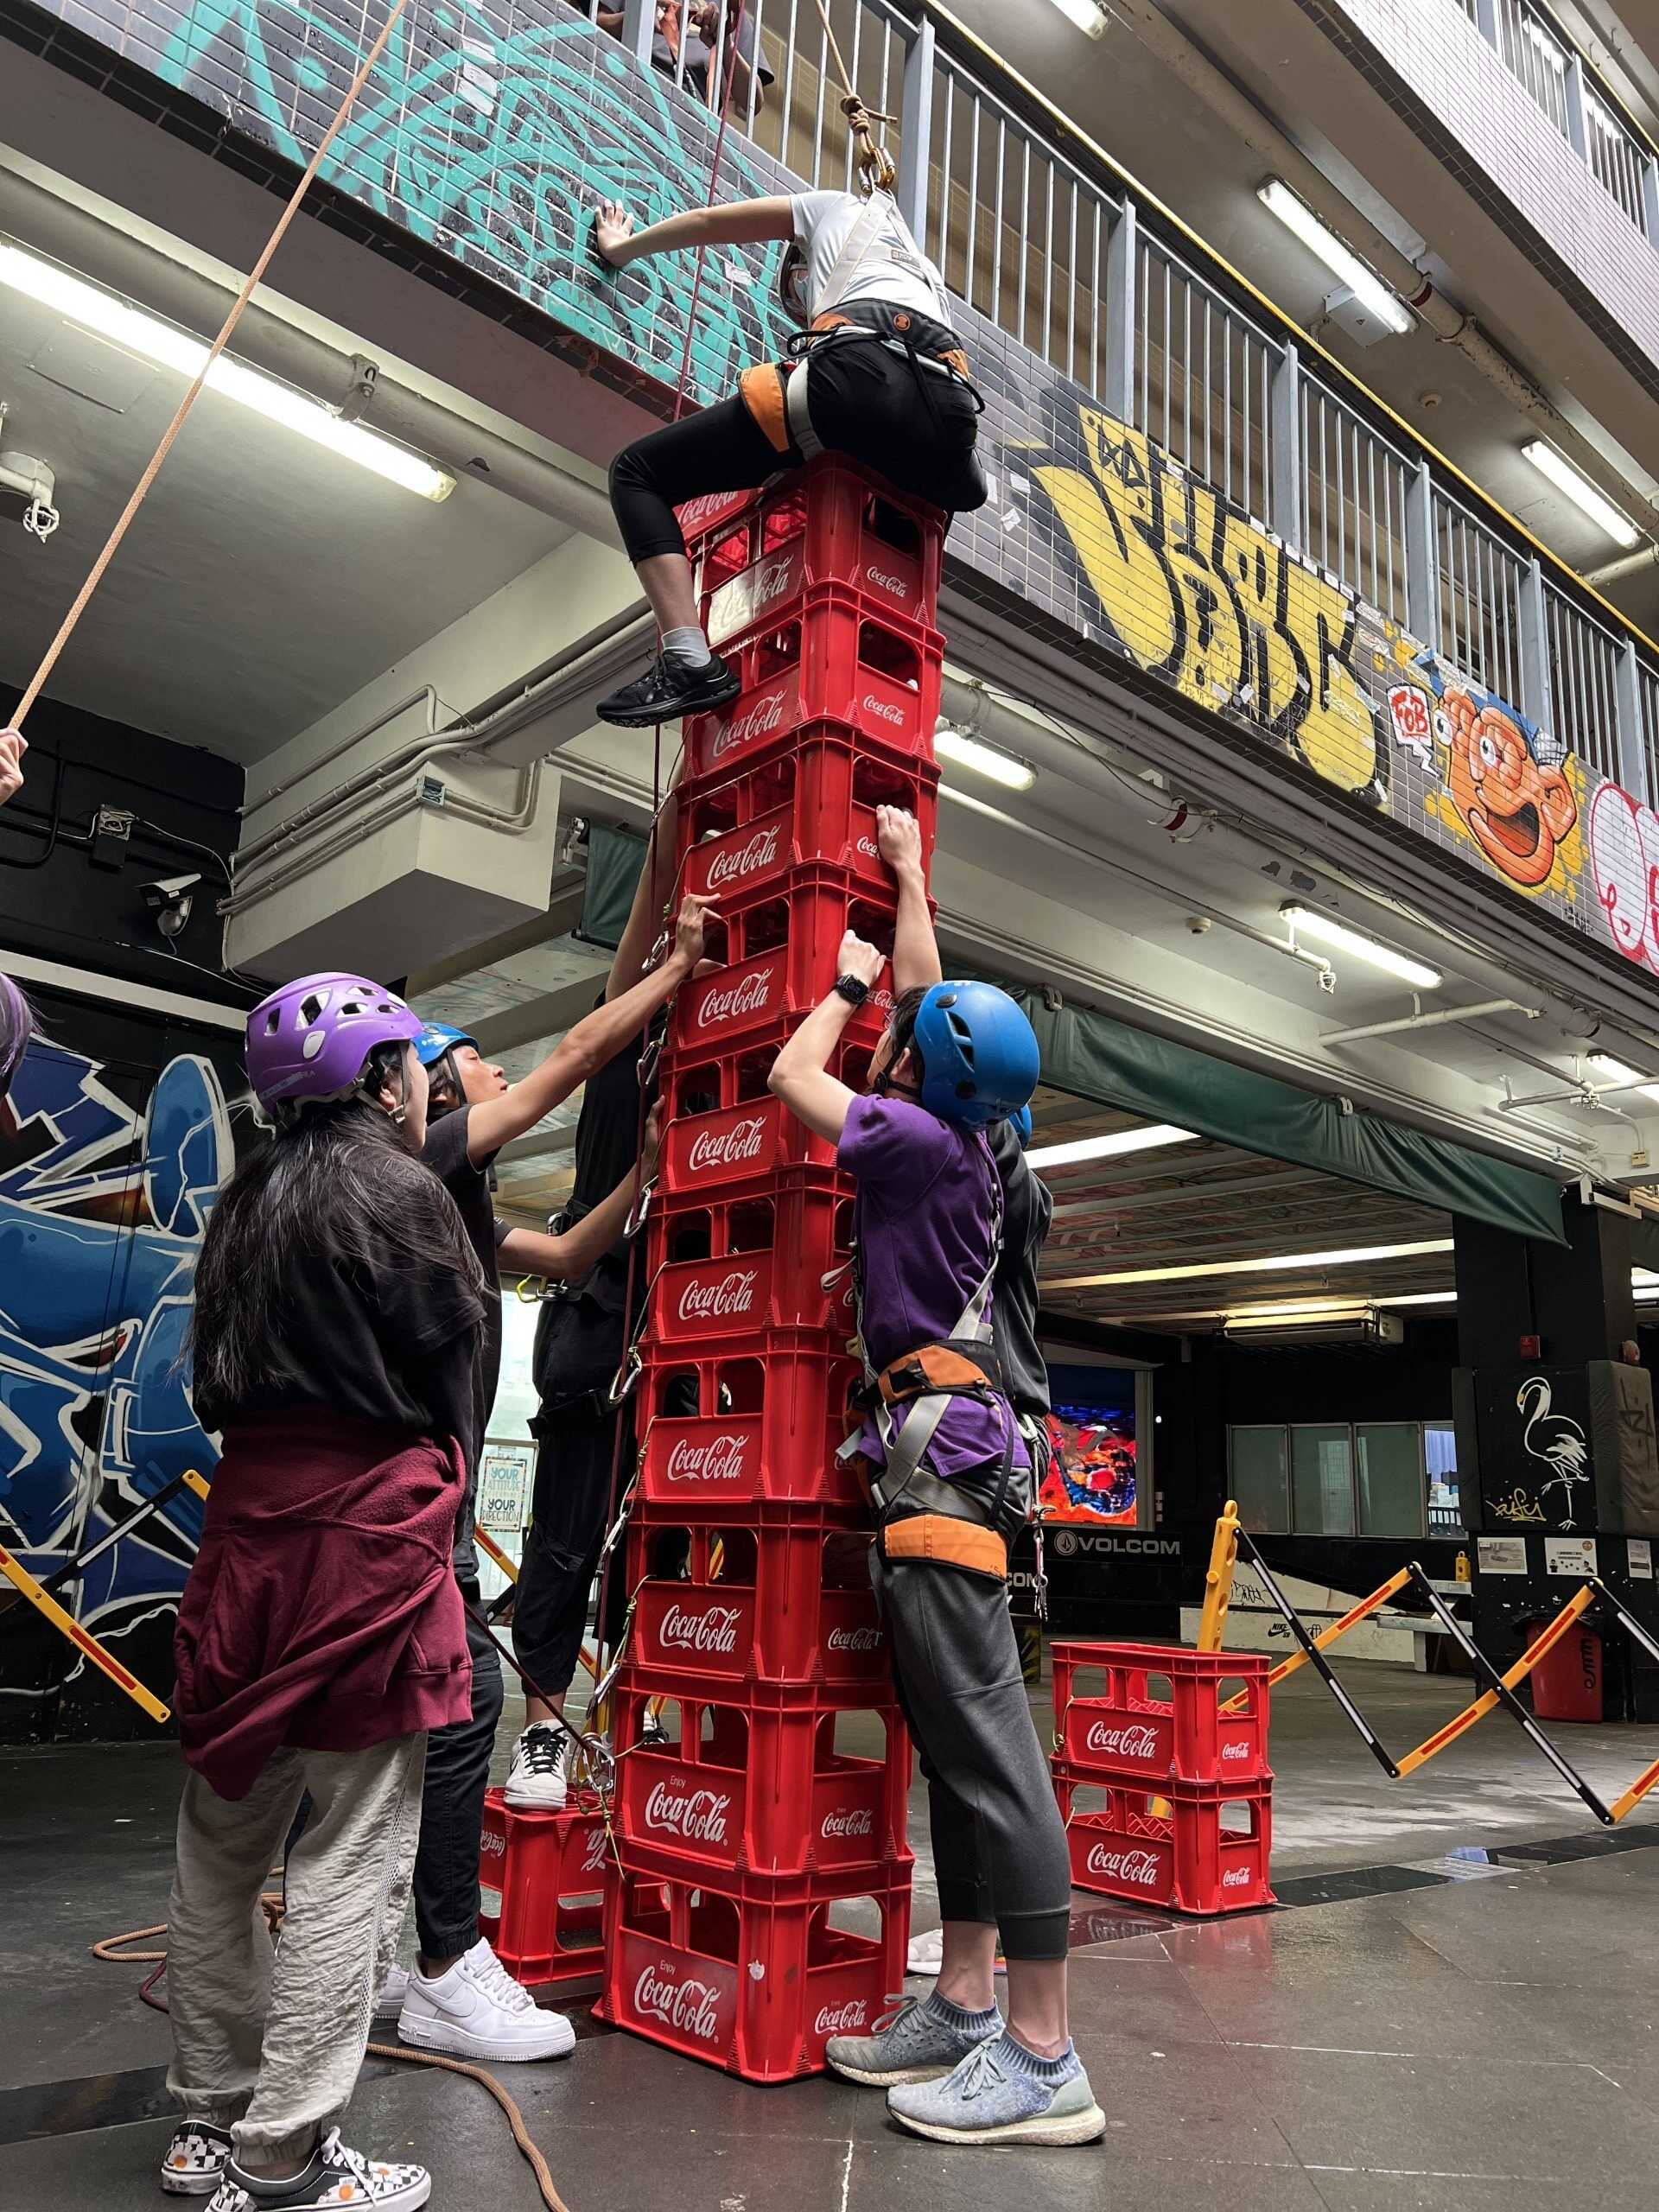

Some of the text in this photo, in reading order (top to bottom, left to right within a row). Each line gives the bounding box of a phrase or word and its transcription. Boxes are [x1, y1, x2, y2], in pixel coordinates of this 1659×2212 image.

[867, 566, 908, 598] Coca-Cola
[713, 690, 788, 757] Coca-Cola
[863, 695, 905, 727] Coca-Cola
[707, 823, 781, 890] Coca-Cola
[698, 968, 774, 1028] Coca-Cola
[690, 1116, 767, 1171] Coca-Cola
[678, 1270, 759, 1321] Coca-Cola
[667, 1435, 749, 1481] Coca-Cola
[487, 1498, 516, 1511] YOUR
[1077, 1536, 1181, 1555] VOLCOM
[659, 1605, 742, 1653] Coca-Cola
[1272, 1623, 1287, 1631] NIKE
[1086, 1720, 1160, 1759] Coca-Cola
[645, 1782, 731, 1842] Coca-Cola
[821, 1809, 873, 1839] Coca-Cola
[1086, 1842, 1161, 1885] Coca-Cola
[634, 1965, 721, 2038] Coca-Cola
[815, 1999, 867, 2034] Coca-Cola
